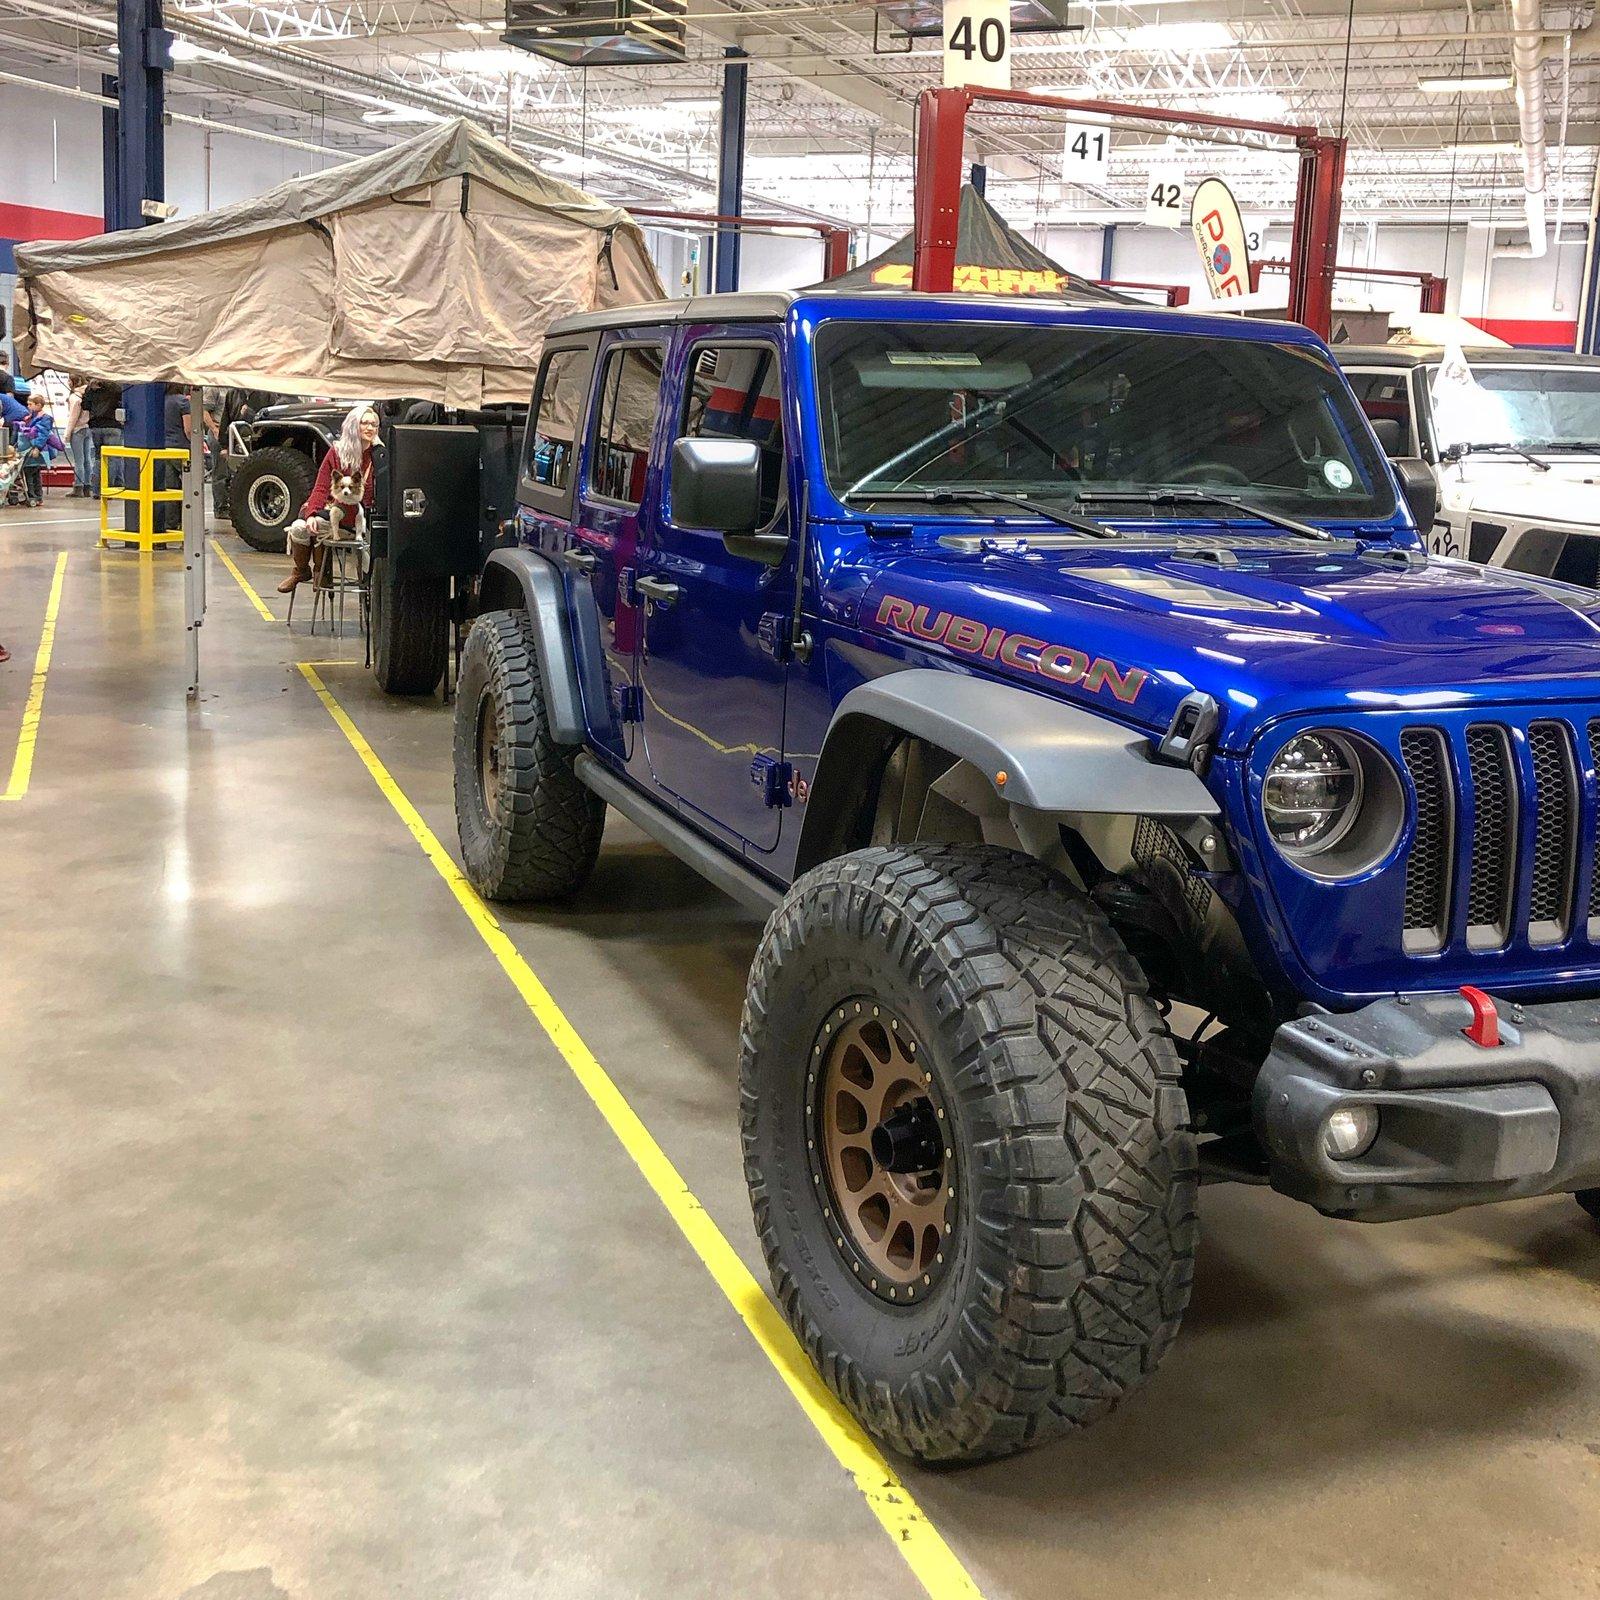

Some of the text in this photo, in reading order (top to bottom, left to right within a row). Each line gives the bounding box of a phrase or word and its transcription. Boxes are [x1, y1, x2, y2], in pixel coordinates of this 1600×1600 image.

[949, 16, 1006, 63] 40
[1071, 131, 1104, 162] 41
[1150, 183, 1181, 209] 42
[1246, 231, 1260, 251] 3
[875, 595, 1149, 704] RUBICON
[787, 768, 809, 803] Je
